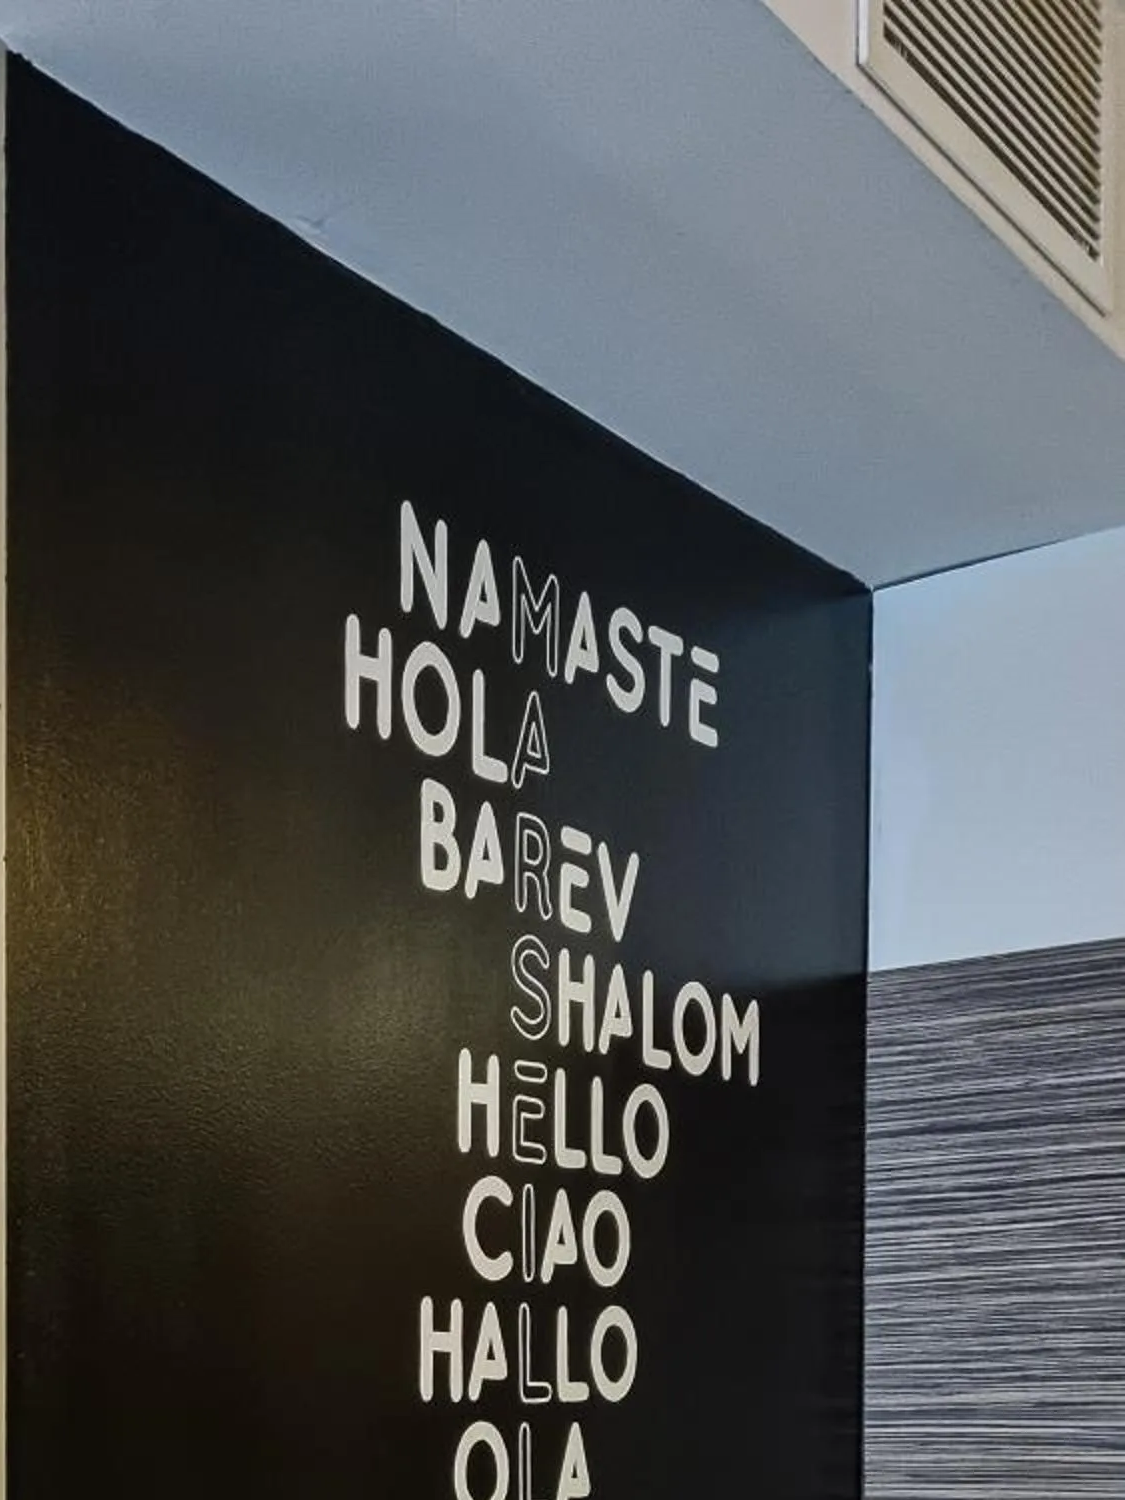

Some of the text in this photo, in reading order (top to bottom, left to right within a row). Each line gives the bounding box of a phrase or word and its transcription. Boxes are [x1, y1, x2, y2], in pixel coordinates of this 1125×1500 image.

[400, 500, 720, 748] NAMASTE
[344, 613, 551, 790] HOLA
[419, 778, 640, 942] BAREV
[510, 935, 761, 1086] SHALOM
[457, 1048, 670, 1179] HELLO
[462, 1175, 632, 1288] CIAO
[419, 1295, 639, 1403] HALLO
